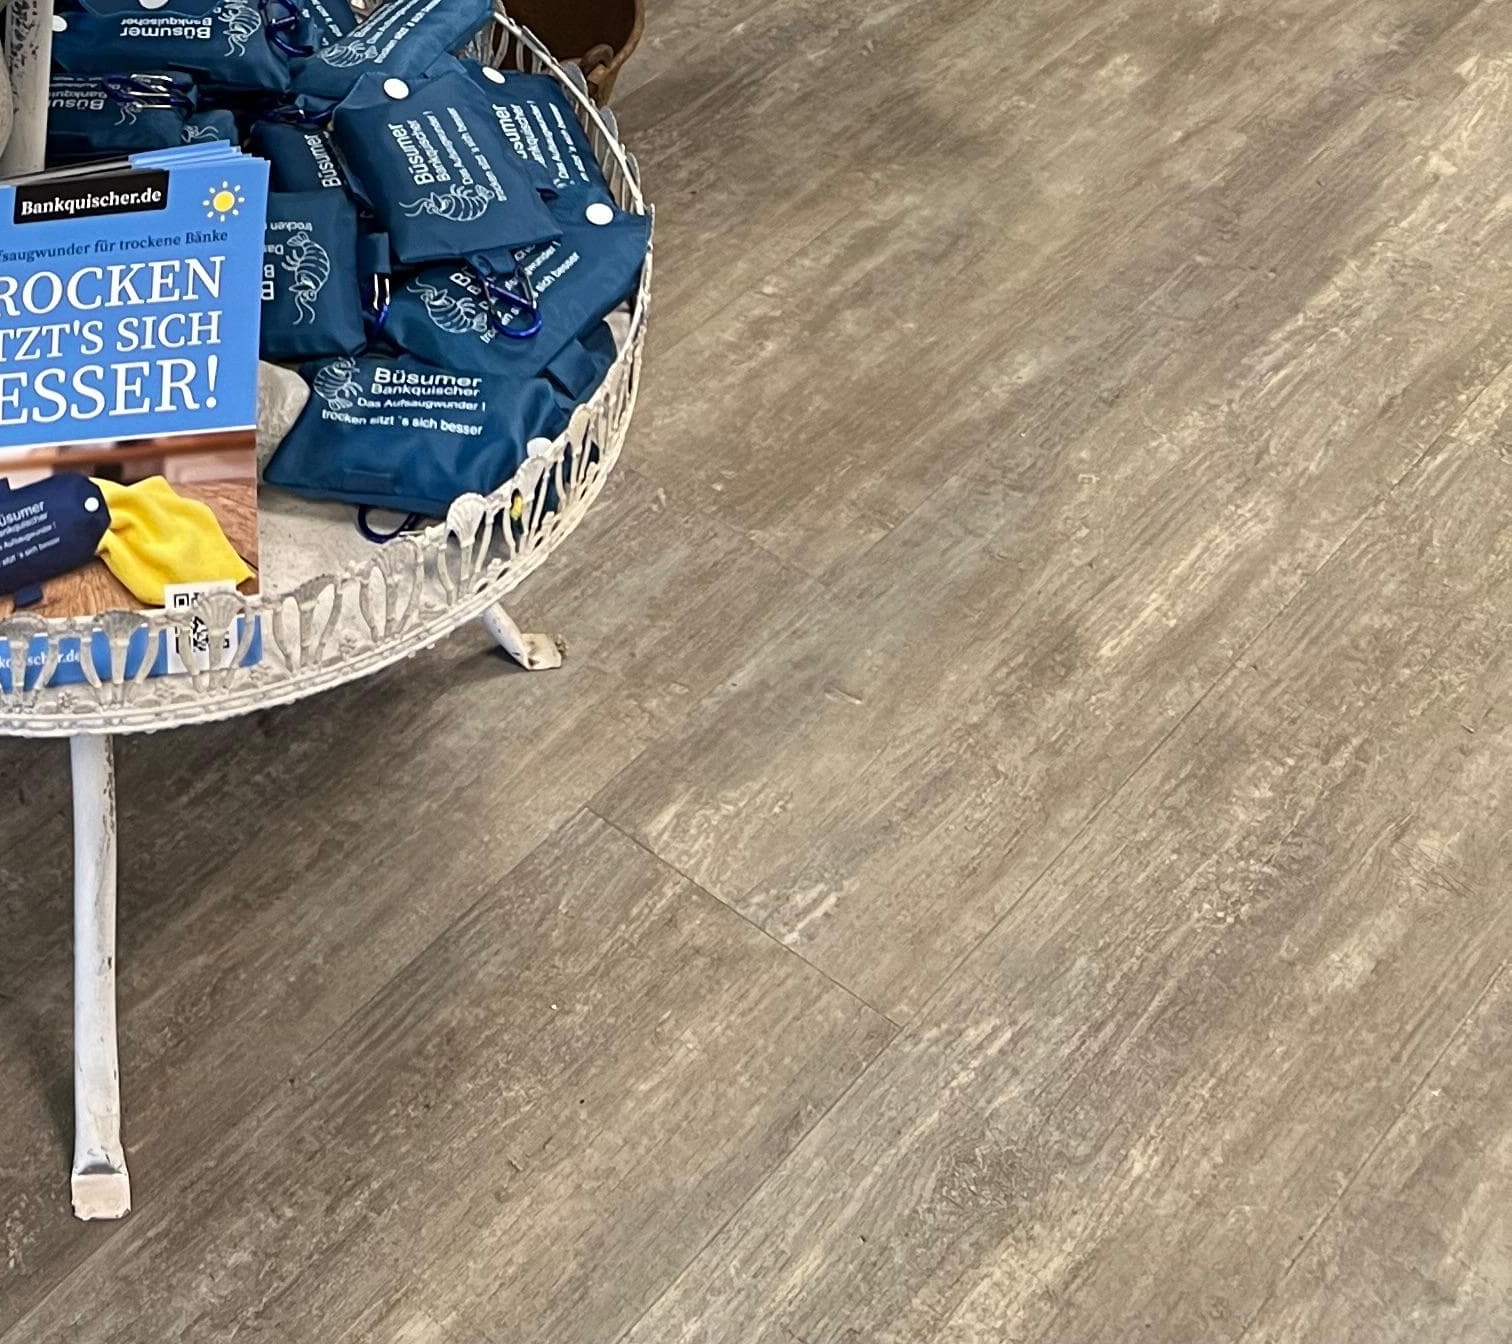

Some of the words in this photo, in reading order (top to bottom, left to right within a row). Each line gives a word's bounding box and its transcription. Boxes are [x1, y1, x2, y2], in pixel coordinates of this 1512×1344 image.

[119, 25, 212, 41] Büsumer
[304, 133, 342, 188] Büsumer
[387, 123, 436, 186] Büsumer
[21, 186, 163, 217] Bankquischer.de
[93, 238, 117, 254] für
[119, 234, 182, 251] trockene
[185, 229, 229, 244] Bänke
[115, 311, 223, 352] SICH
[371, 383, 480, 397] Bankquischer
[374, 367, 482, 388] Büsumer
[357, 396, 381, 409] Das
[383, 399, 478, 411] Aufsaugwunder
[322, 409, 367, 425] trocken
[370, 415, 395, 425] sitzt
[412, 417, 438, 430] sich
[440, 420, 483, 436] besser
